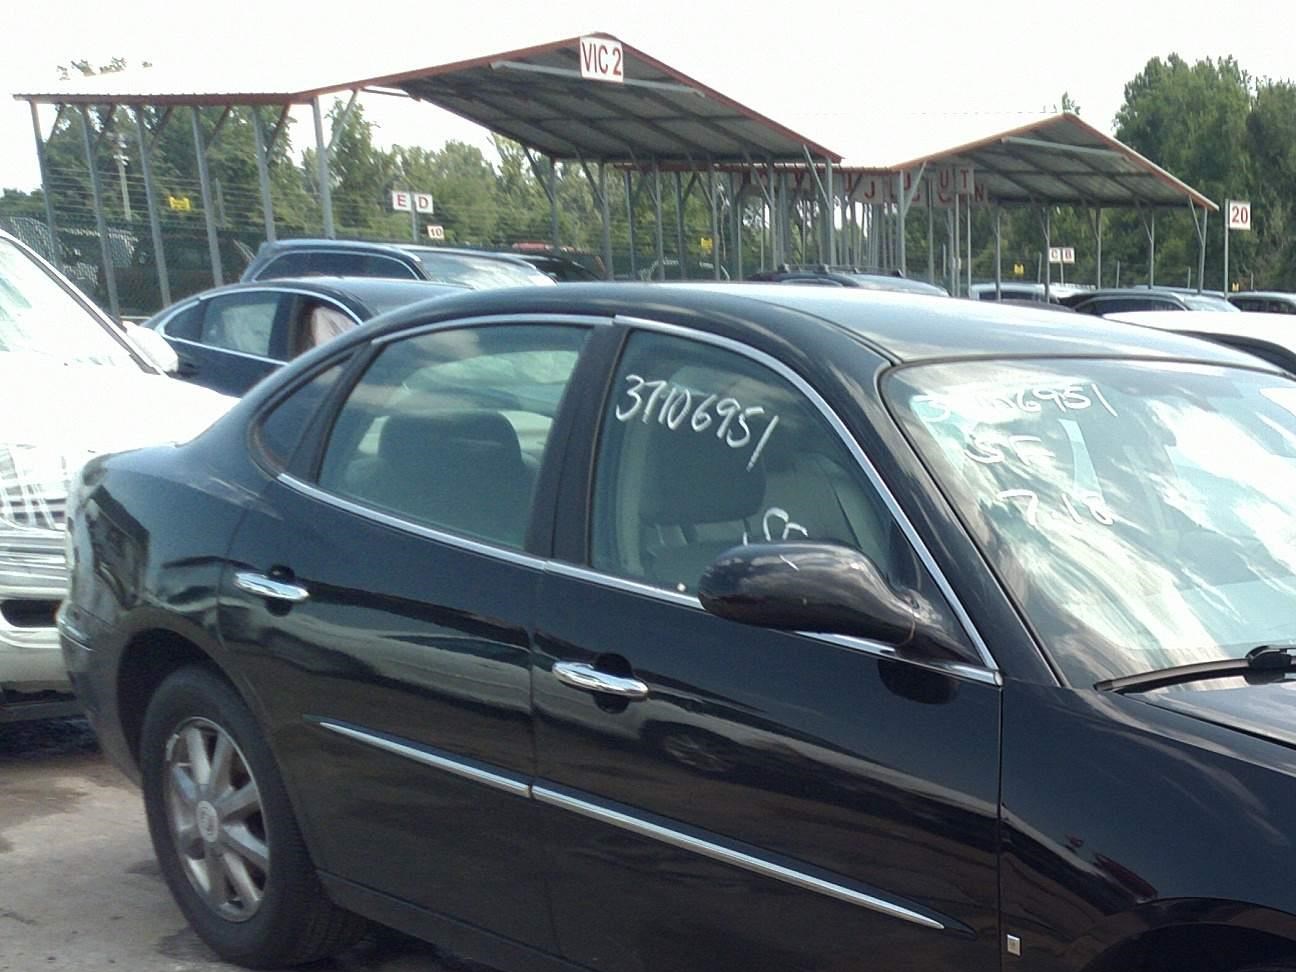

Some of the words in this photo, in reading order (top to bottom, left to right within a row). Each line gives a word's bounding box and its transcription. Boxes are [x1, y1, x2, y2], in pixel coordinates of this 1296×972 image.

[581, 41, 609, 74] VIC
[612, 46, 622, 76] 2
[396, 193, 408, 208] E
[418, 195, 430, 210] D
[1231, 205, 1249, 225] 20
[615, 374, 780, 473] 37106951
